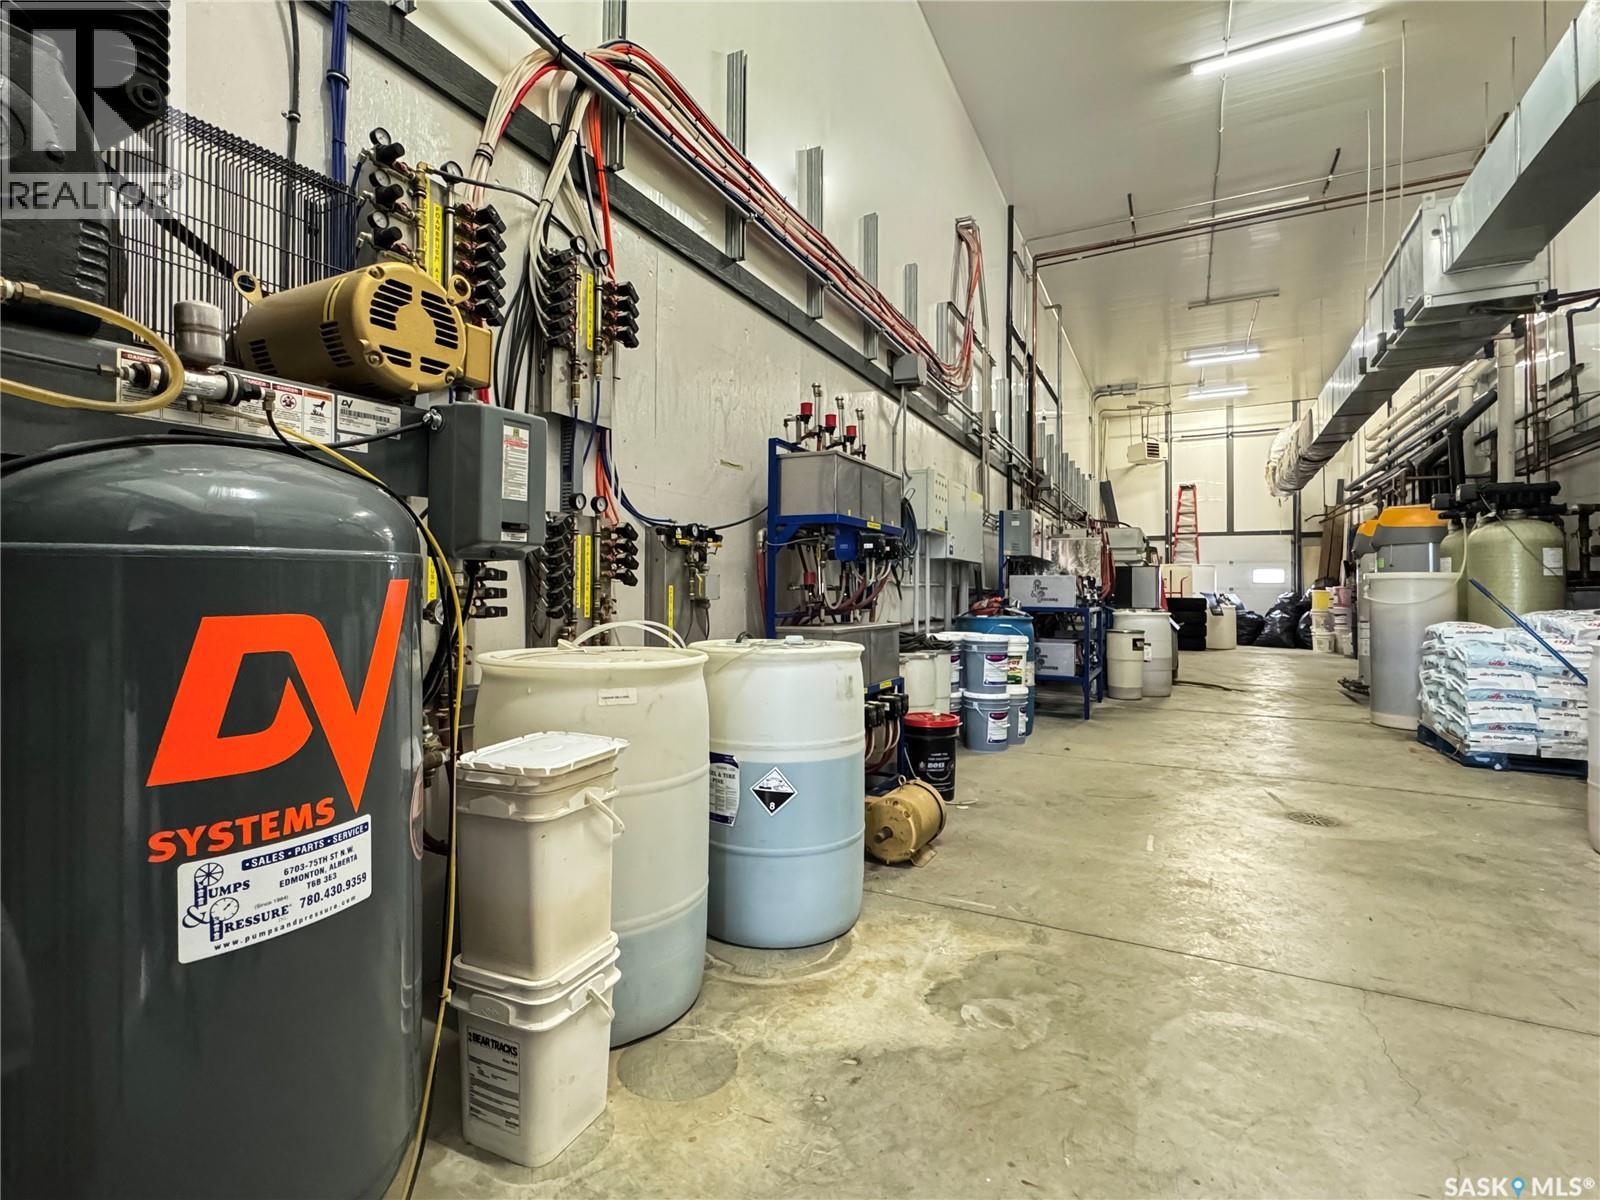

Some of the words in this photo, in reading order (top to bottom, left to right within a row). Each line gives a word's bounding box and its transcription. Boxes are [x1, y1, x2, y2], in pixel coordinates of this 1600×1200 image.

[145, 579, 409, 814] DV
[769, 801, 776, 810] 8
[147, 797, 335, 863] SYSTEMS
[251, 851, 285, 867] SALES
[294, 839, 325, 856] PARTS
[332, 824, 364, 843] SERVICE
[283, 855, 328, 876] 6703-75TH
[330, 851, 338, 861] ST
[329, 854, 358, 871] ALBERTA
[299, 872, 367, 909] 780.430.9359
[324, 873, 337, 884] 3E3
[214, 896, 356, 950] www.pumpsandpressure.com
[473, 1032, 490, 1047] BEAR
[491, 1039, 518, 1057] TRACKS
